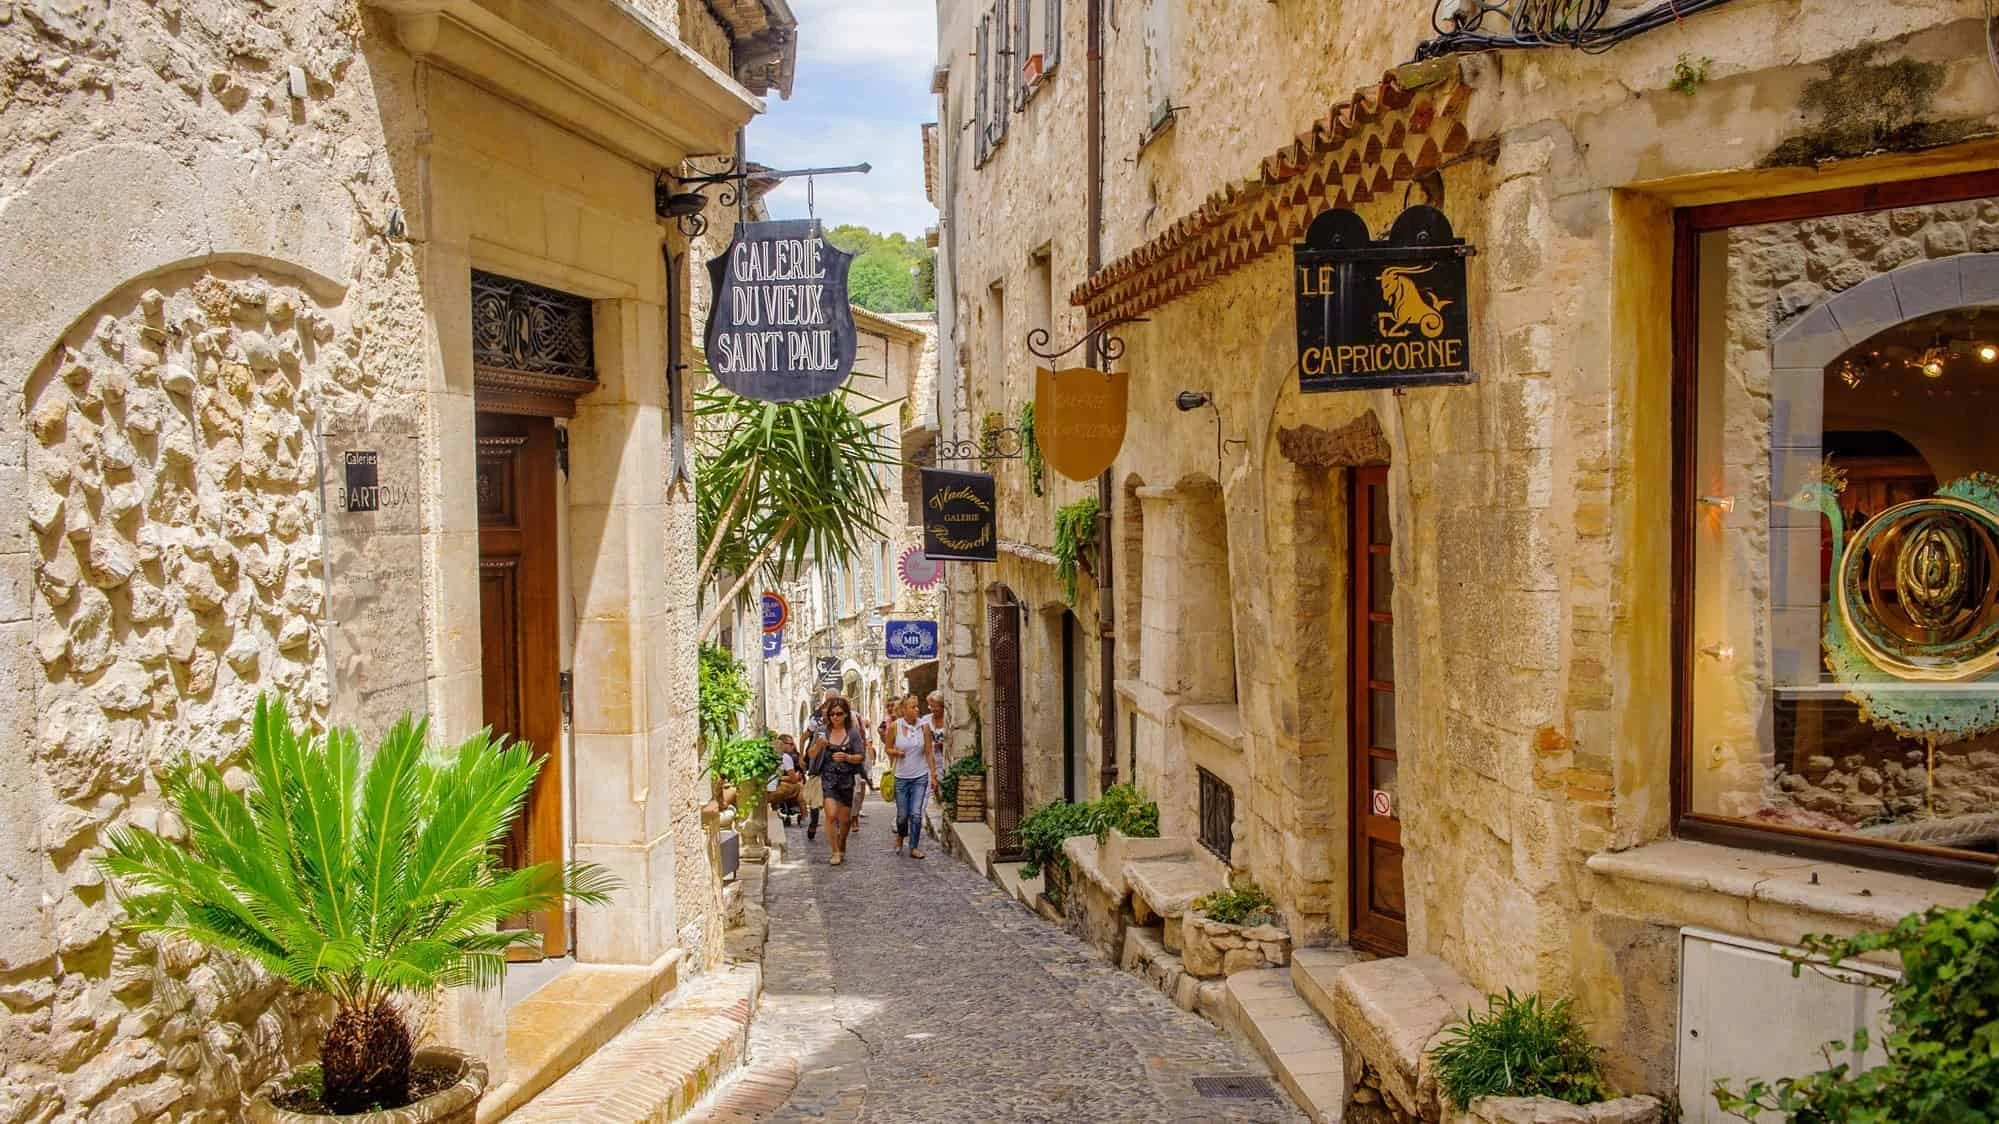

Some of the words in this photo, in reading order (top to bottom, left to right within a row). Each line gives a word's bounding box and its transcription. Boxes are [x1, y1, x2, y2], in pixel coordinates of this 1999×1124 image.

[733, 237, 826, 282] GALERIE
[1301, 264, 1336, 296] LE
[732, 286, 760, 326] DU
[763, 284, 824, 326] VIEUX
[718, 331, 784, 373] SAINT
[788, 330, 839, 371] PAUL
[1302, 339, 1463, 376] CAPRICORNE
[346, 452, 377, 465] Galeries
[338, 486, 410, 509] BARTOUX
[944, 513, 980, 522] GALERIE
